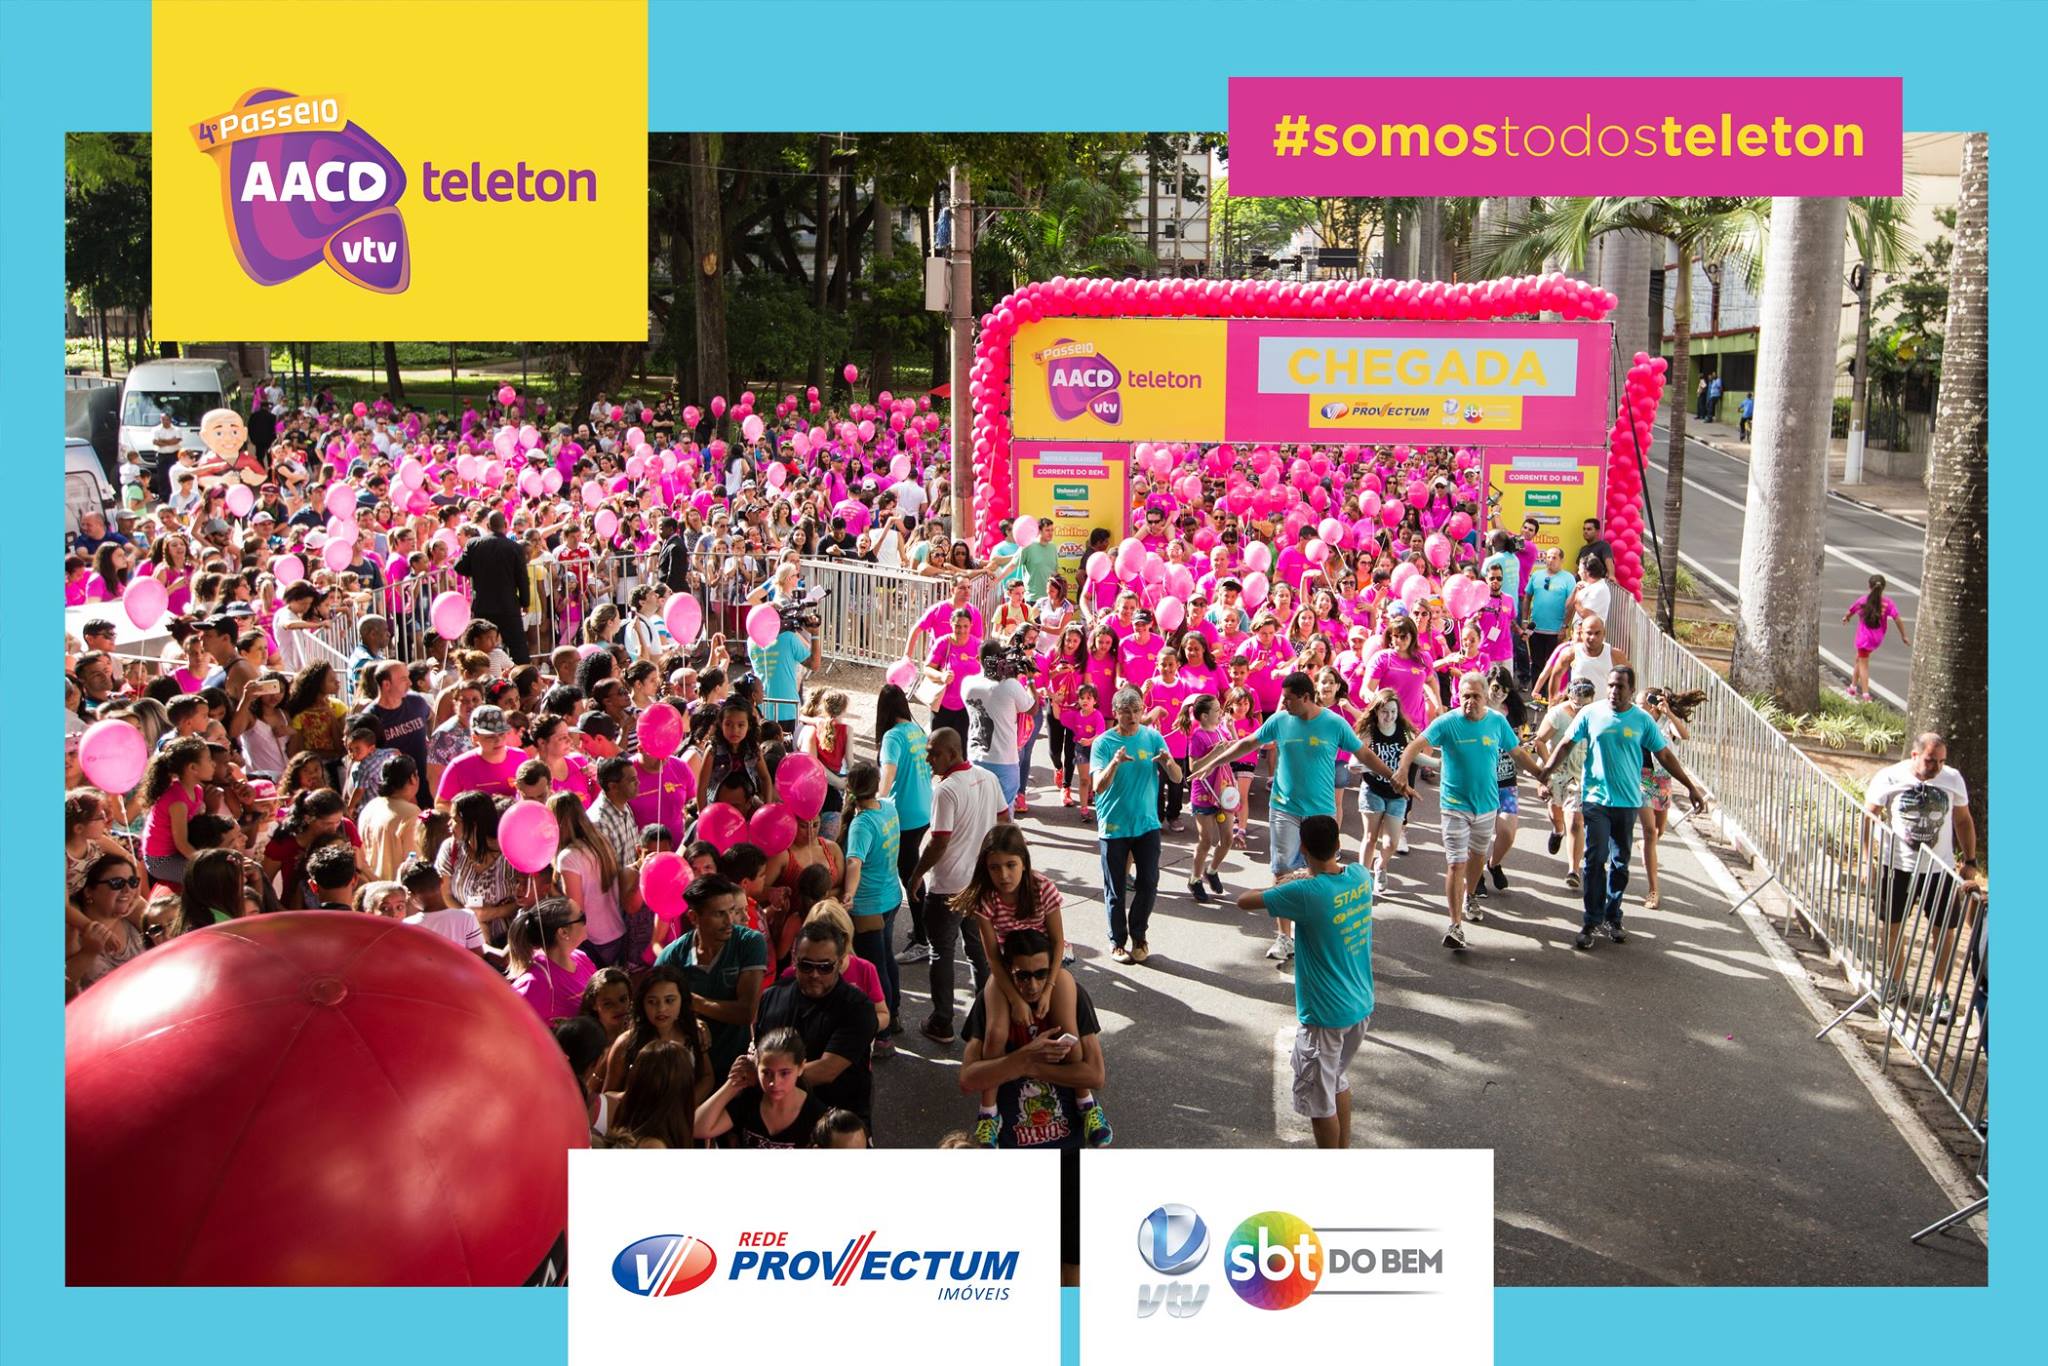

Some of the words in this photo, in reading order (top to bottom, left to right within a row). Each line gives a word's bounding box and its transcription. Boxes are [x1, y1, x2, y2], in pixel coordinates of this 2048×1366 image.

[1287, 347, 1548, 387] CHEGADA
[1052, 369, 1114, 388] AACD
[1128, 370, 1202, 389] teleton
[1094, 401, 1118, 413] vtv
[1464, 405, 1485, 418] sbt
[1037, 468, 1075, 476] CORRENTE
[1509, 474, 1547, 482] CORRENTE
[384, 717, 425, 741] GANGSTER
[1334, 881, 1369, 909] STAFF
[1013, 1119, 1070, 1146] DINOS
